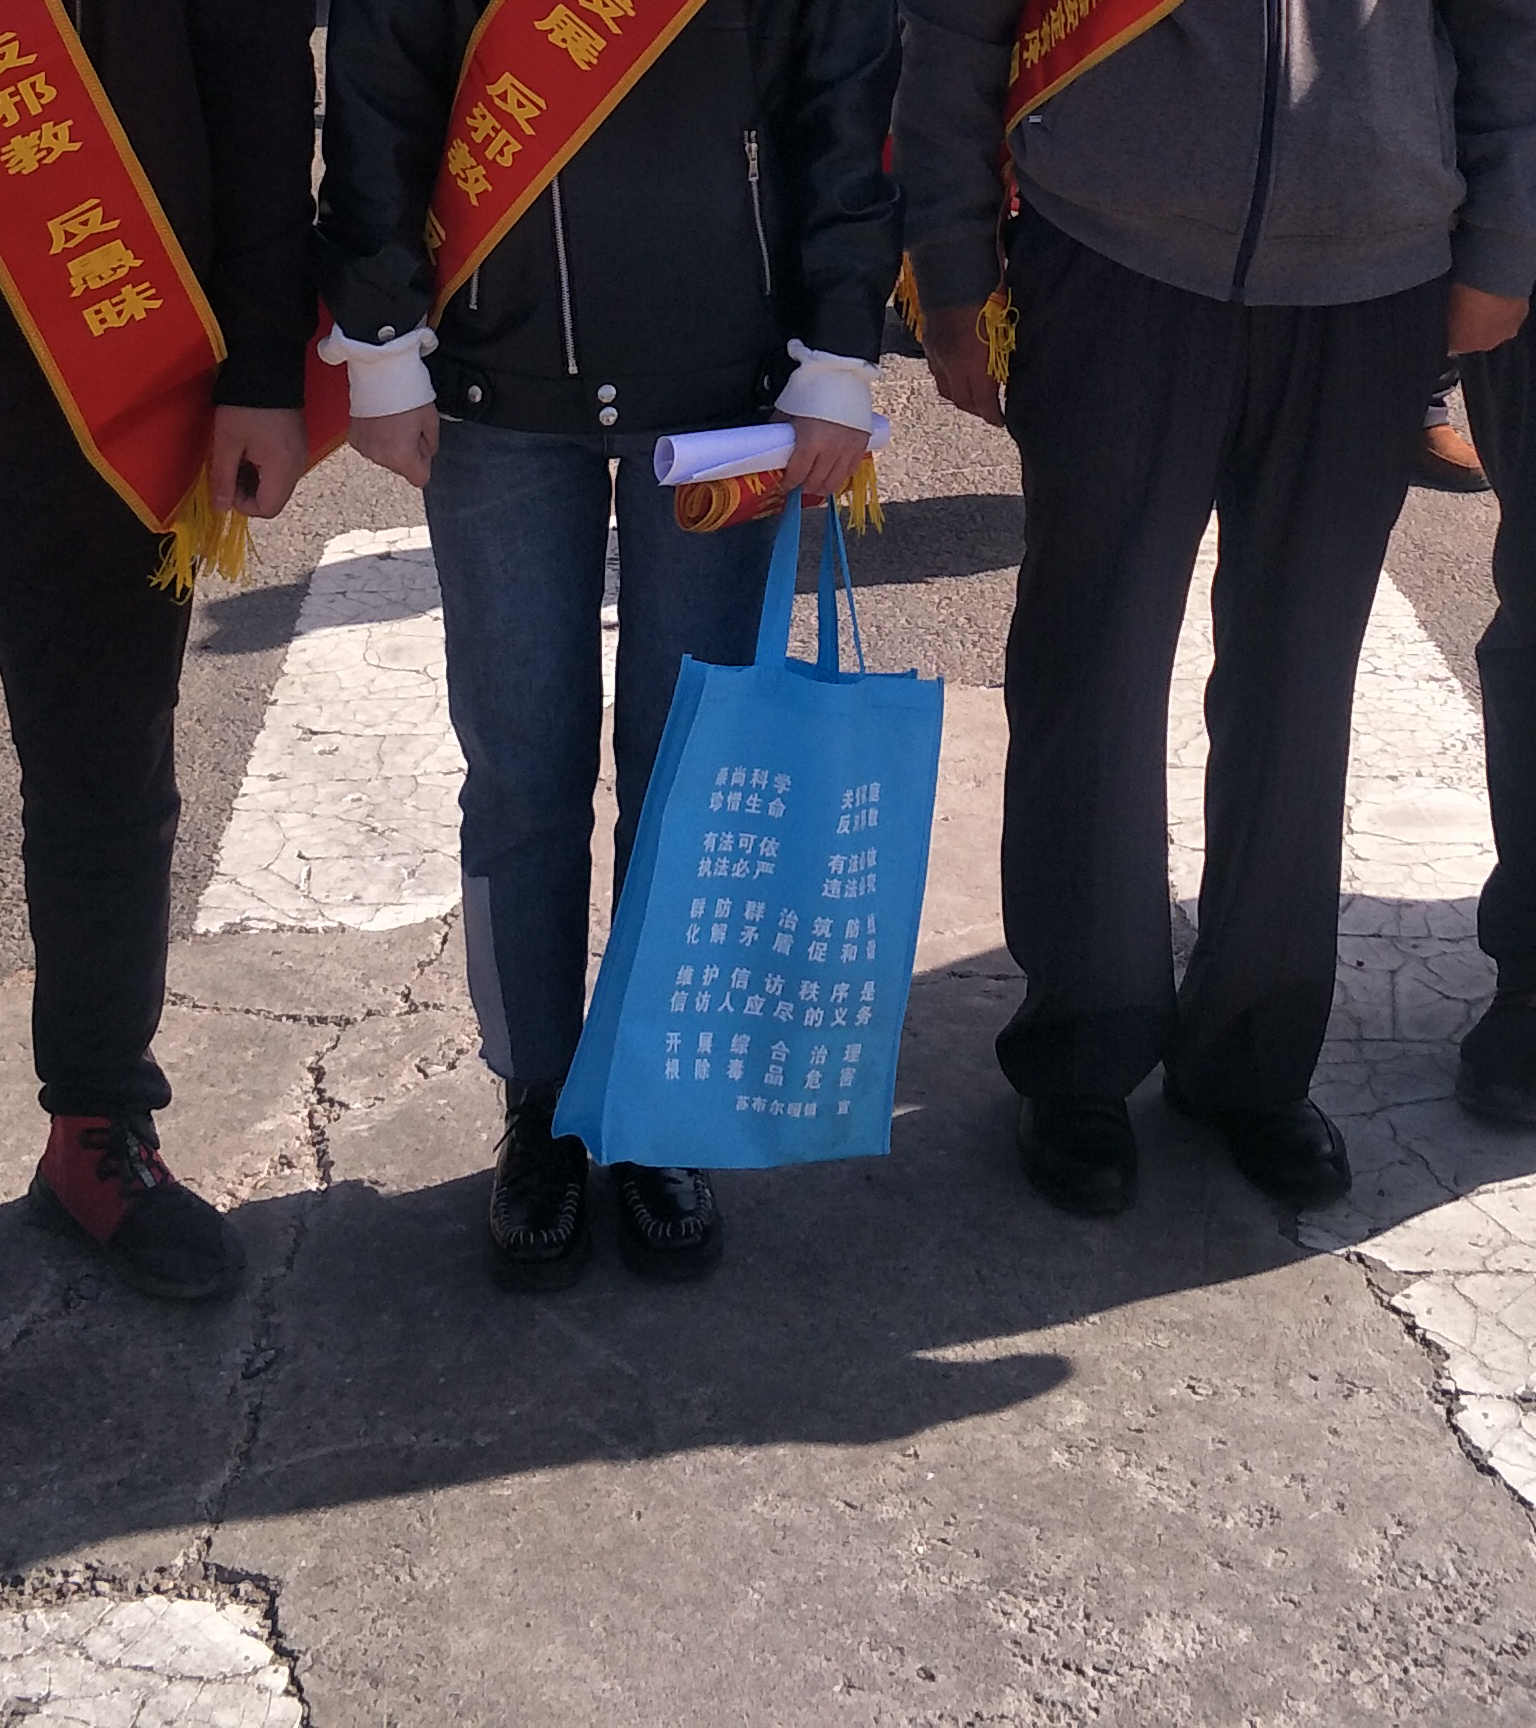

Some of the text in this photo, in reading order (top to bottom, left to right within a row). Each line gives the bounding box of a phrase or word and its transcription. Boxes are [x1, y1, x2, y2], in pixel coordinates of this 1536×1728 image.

[447, 71, 548, 207] 反邪教
[46, 198, 165, 337] 反愚昧
[709, 791, 787, 819] 珍惜生命
[703, 831, 780, 858] 有法可依
[697, 857, 776, 880] 执法必严
[675, 964, 876, 1003] 维护信访秩序是
[670, 990, 873, 1028] 信访人应尽的义务
[666, 1031, 862, 1066] 开展综合治理
[664, 1058, 857, 1090] 根除毒品危害
